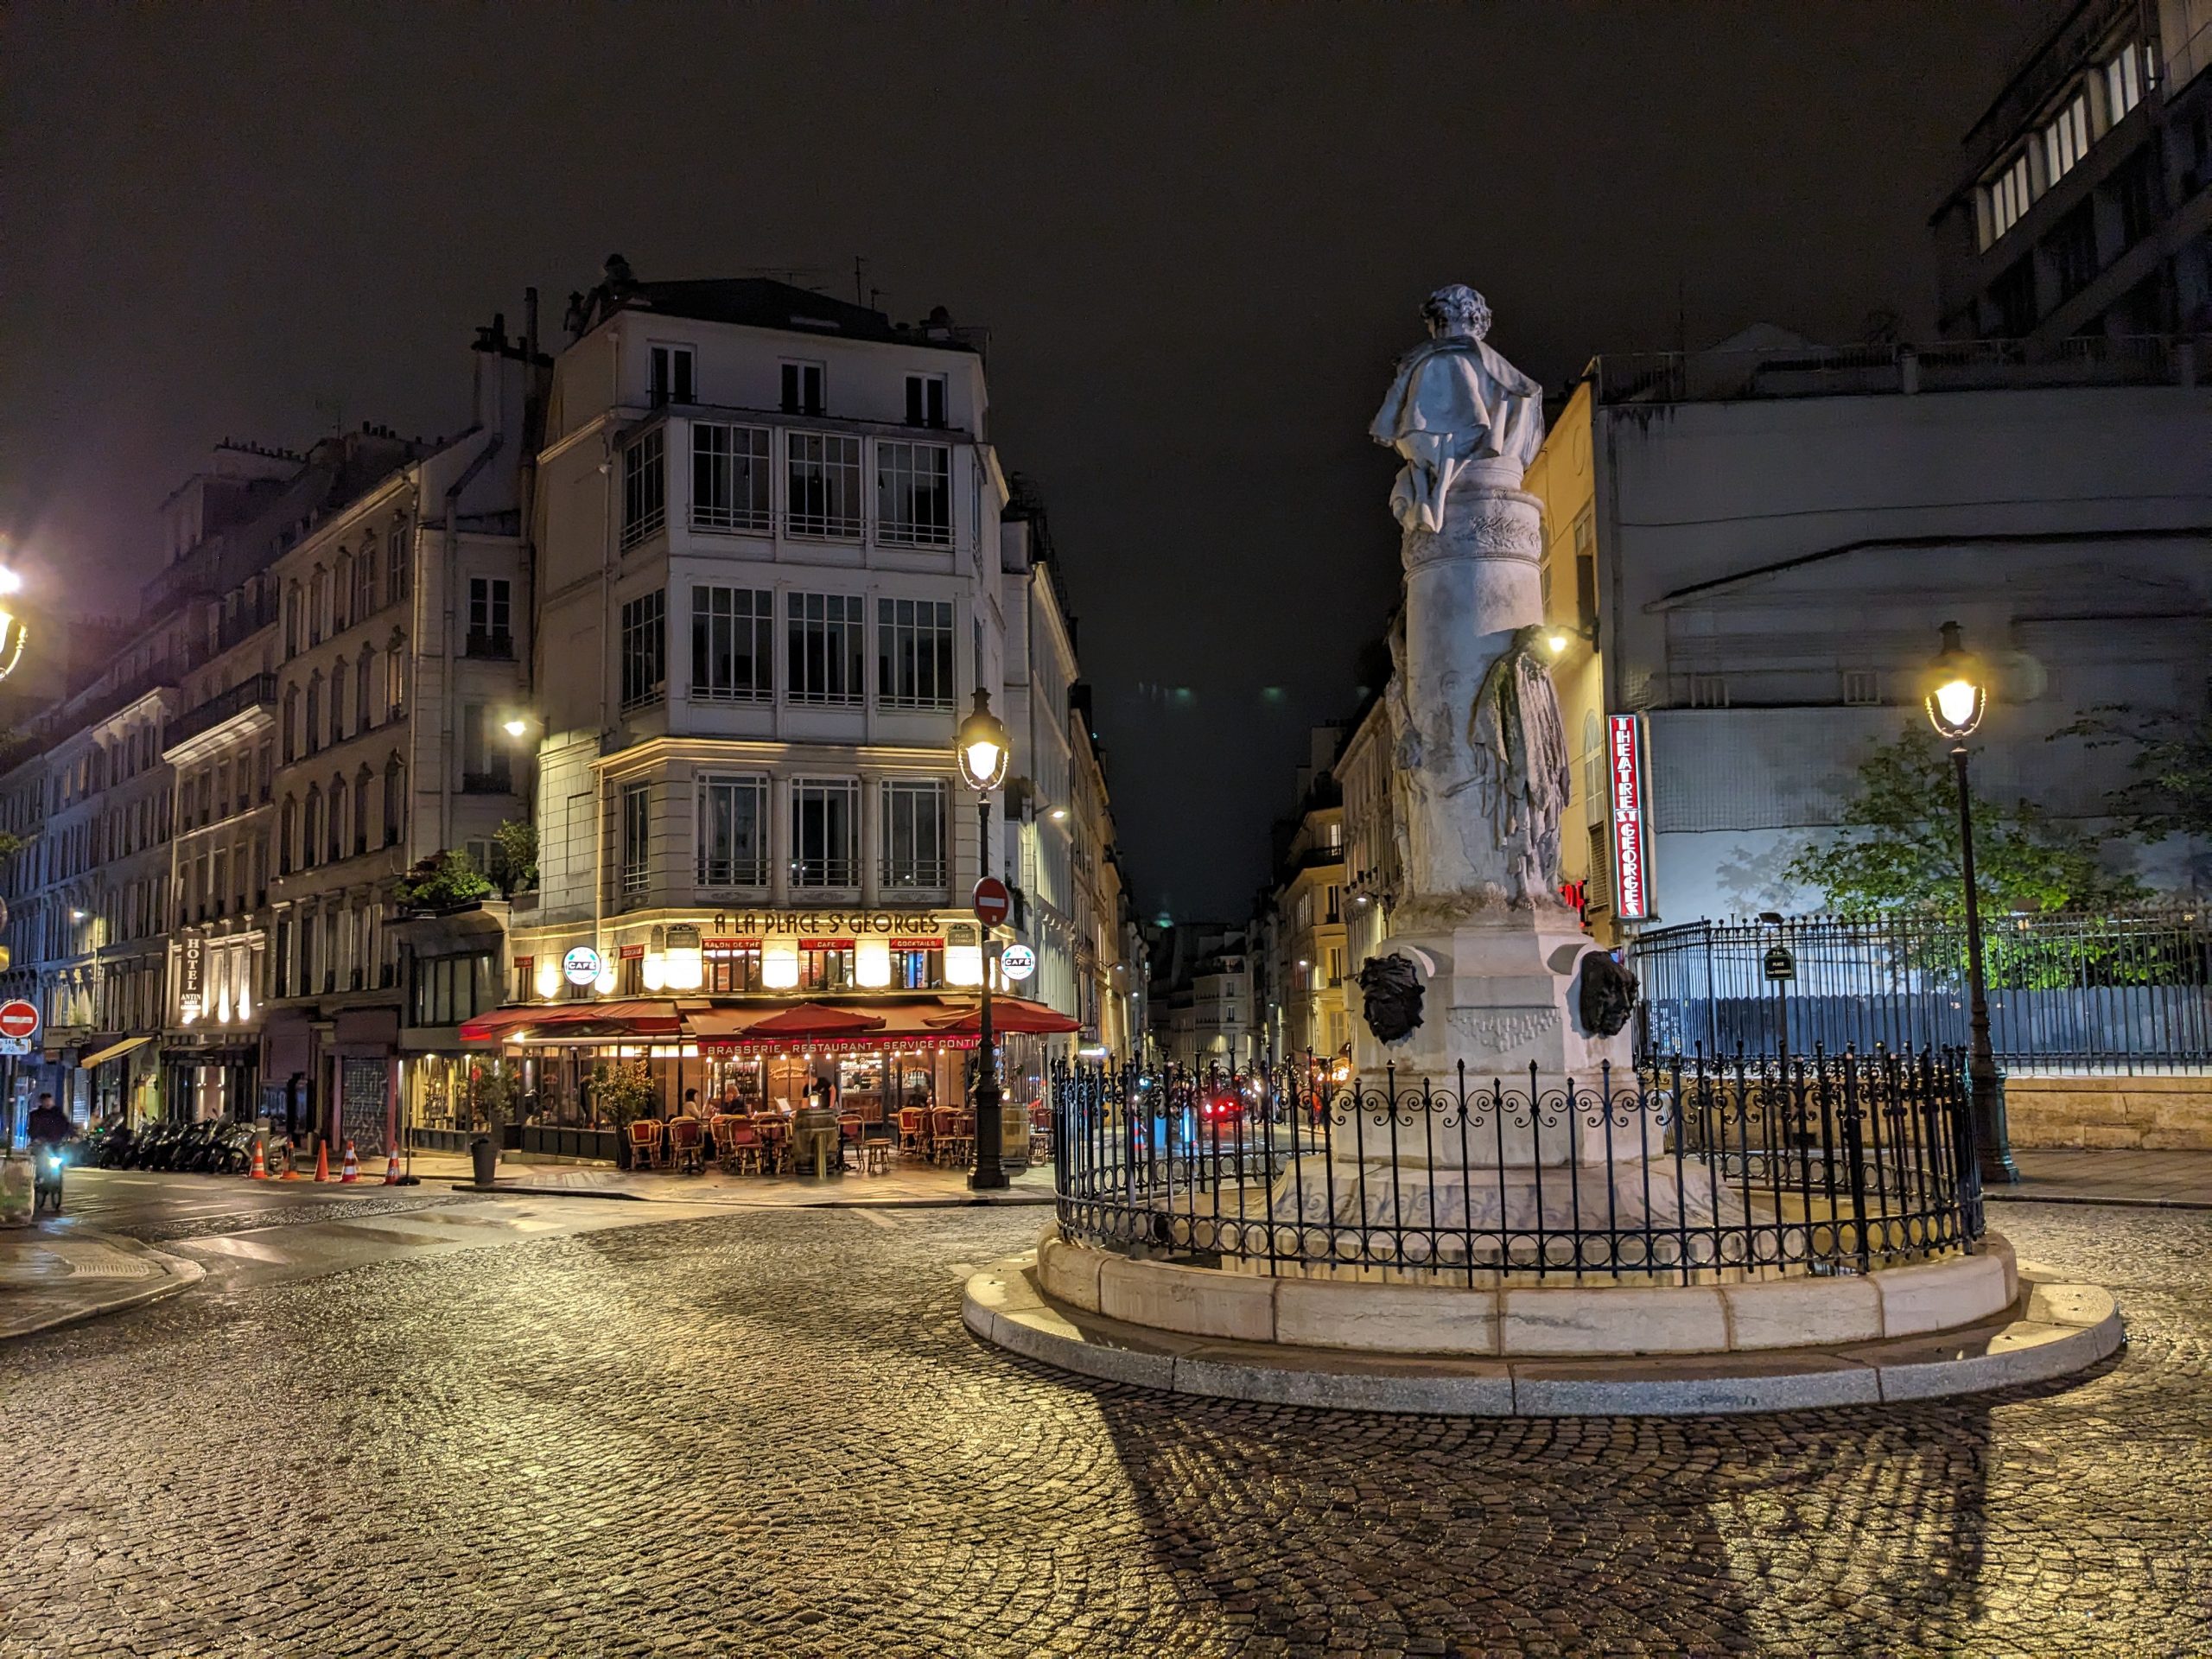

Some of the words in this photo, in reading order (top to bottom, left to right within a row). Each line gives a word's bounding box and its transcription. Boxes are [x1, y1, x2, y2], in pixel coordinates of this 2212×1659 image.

[1616, 717, 1633, 809] THEATRE
[1616, 809, 1638, 823] ST
[1620, 823, 1640, 916] GEORGES
[714, 913, 726, 934] A
[734, 913, 756, 934] LA
[764, 913, 820, 934] PLACE
[849, 913, 940, 934] GEORGES
[187, 938, 200, 990] HOTEL
[708, 1045, 781, 1055] BRASSERIE
[792, 1042, 873, 1052] RESTAURANT
[883, 1039, 934, 1050] SERVICE
